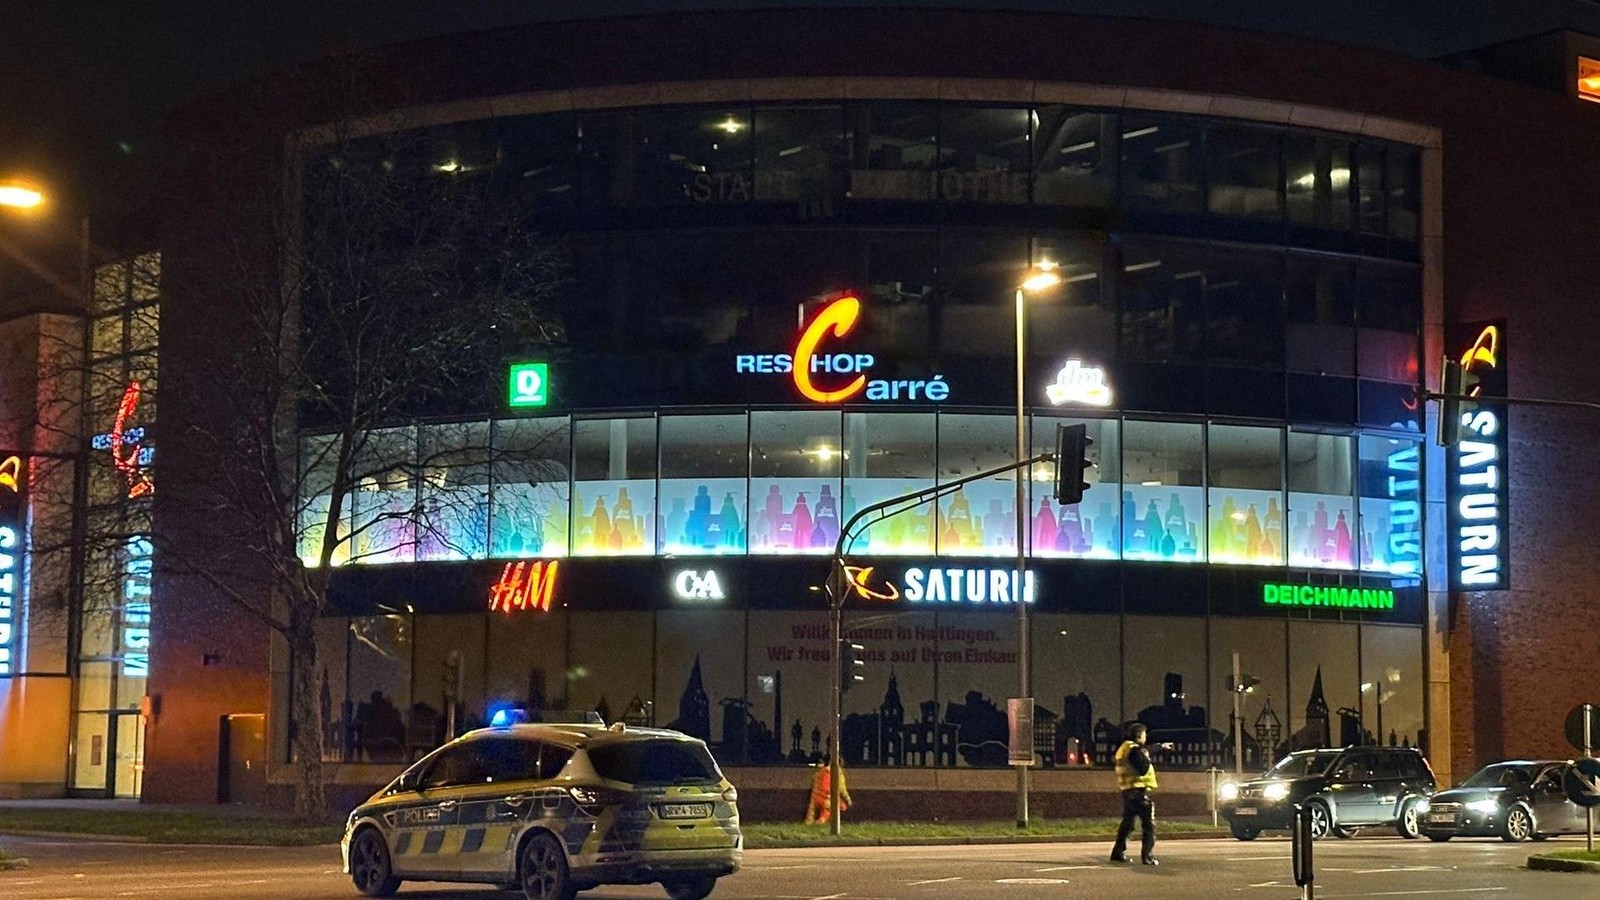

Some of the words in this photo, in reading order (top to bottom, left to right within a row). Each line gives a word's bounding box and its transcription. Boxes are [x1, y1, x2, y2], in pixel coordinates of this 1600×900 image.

[1459, 410, 1498, 586] SATURN
[490, 560, 559, 613] H&M
[904, 568, 1034, 602] SATURN
[1264, 583, 1394, 610] DEICHMANN
[792, 624, 893, 640] Willkmmen
[798, 646, 831, 662] freu
[965, 648, 1017, 663] Einkau
